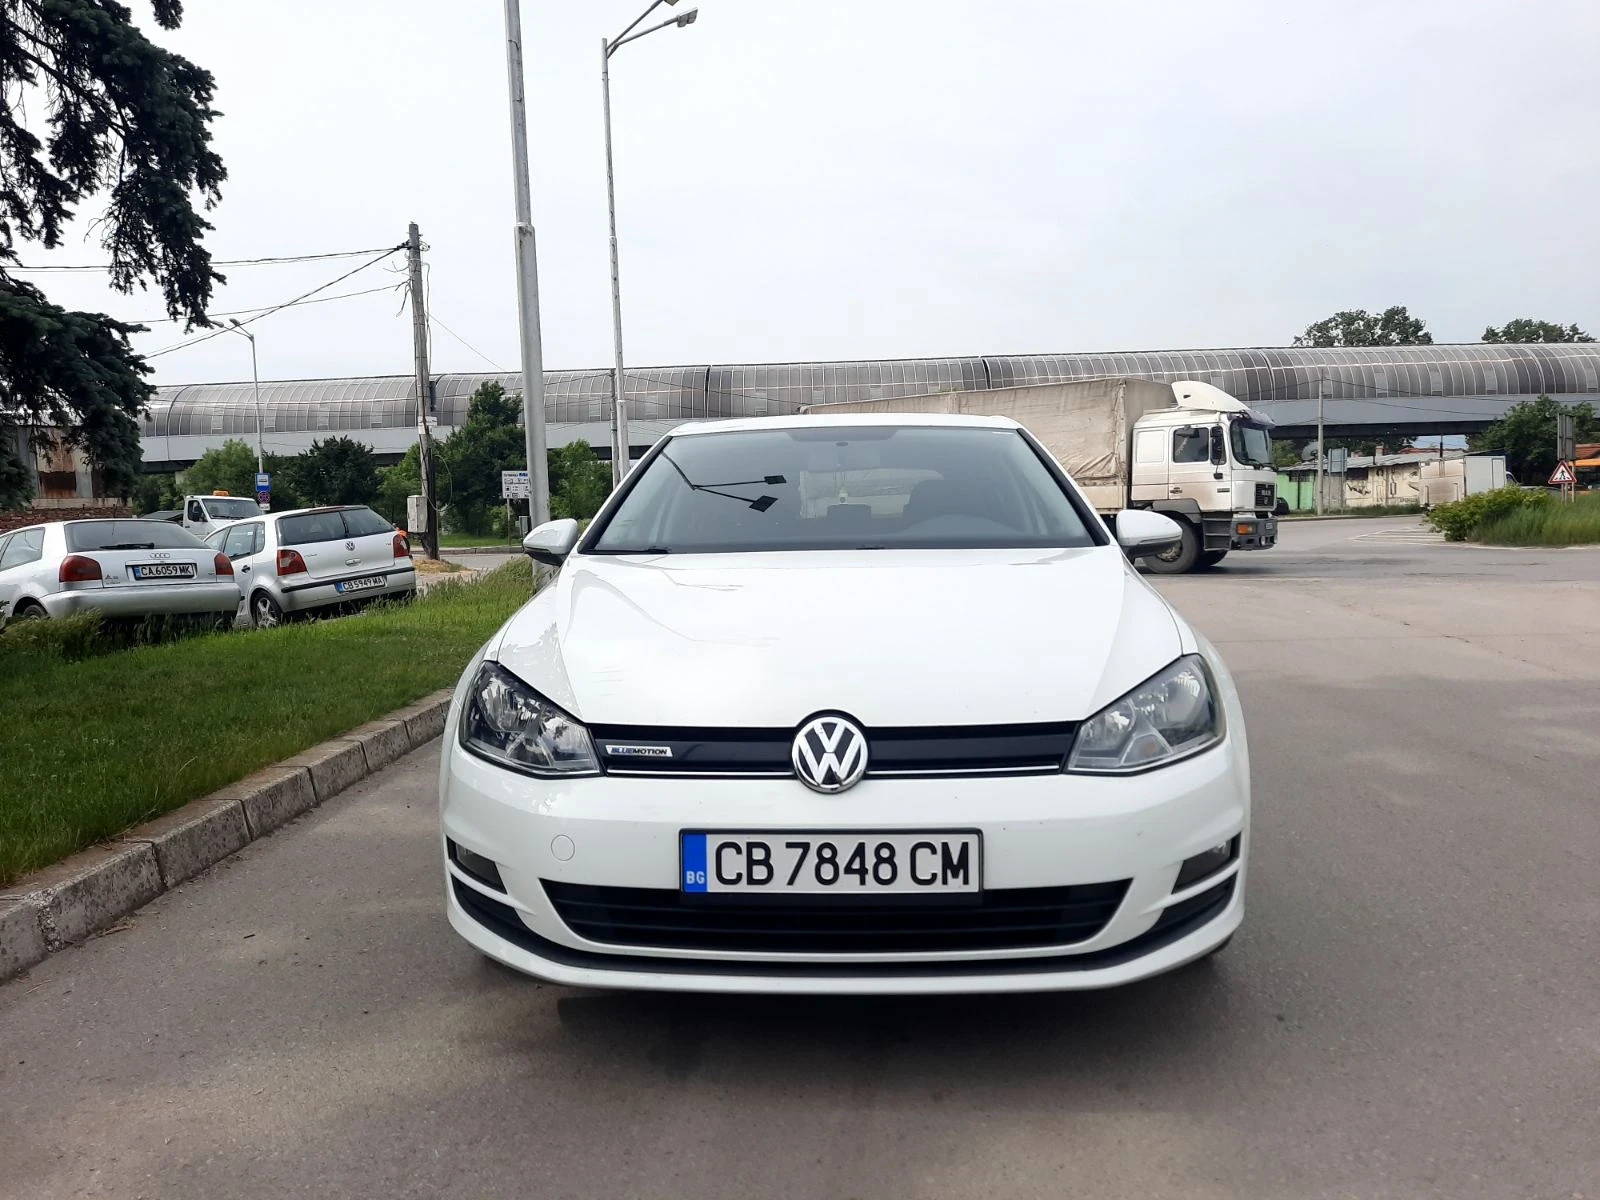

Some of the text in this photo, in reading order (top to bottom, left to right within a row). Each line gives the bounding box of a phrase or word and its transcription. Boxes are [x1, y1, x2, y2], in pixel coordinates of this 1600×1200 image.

[155, 565, 178, 575] 6059
[611, 747, 668, 755] BLUEMOTION
[715, 841, 969, 886] CB 7848 CM
[686, 870, 706, 885] BG
